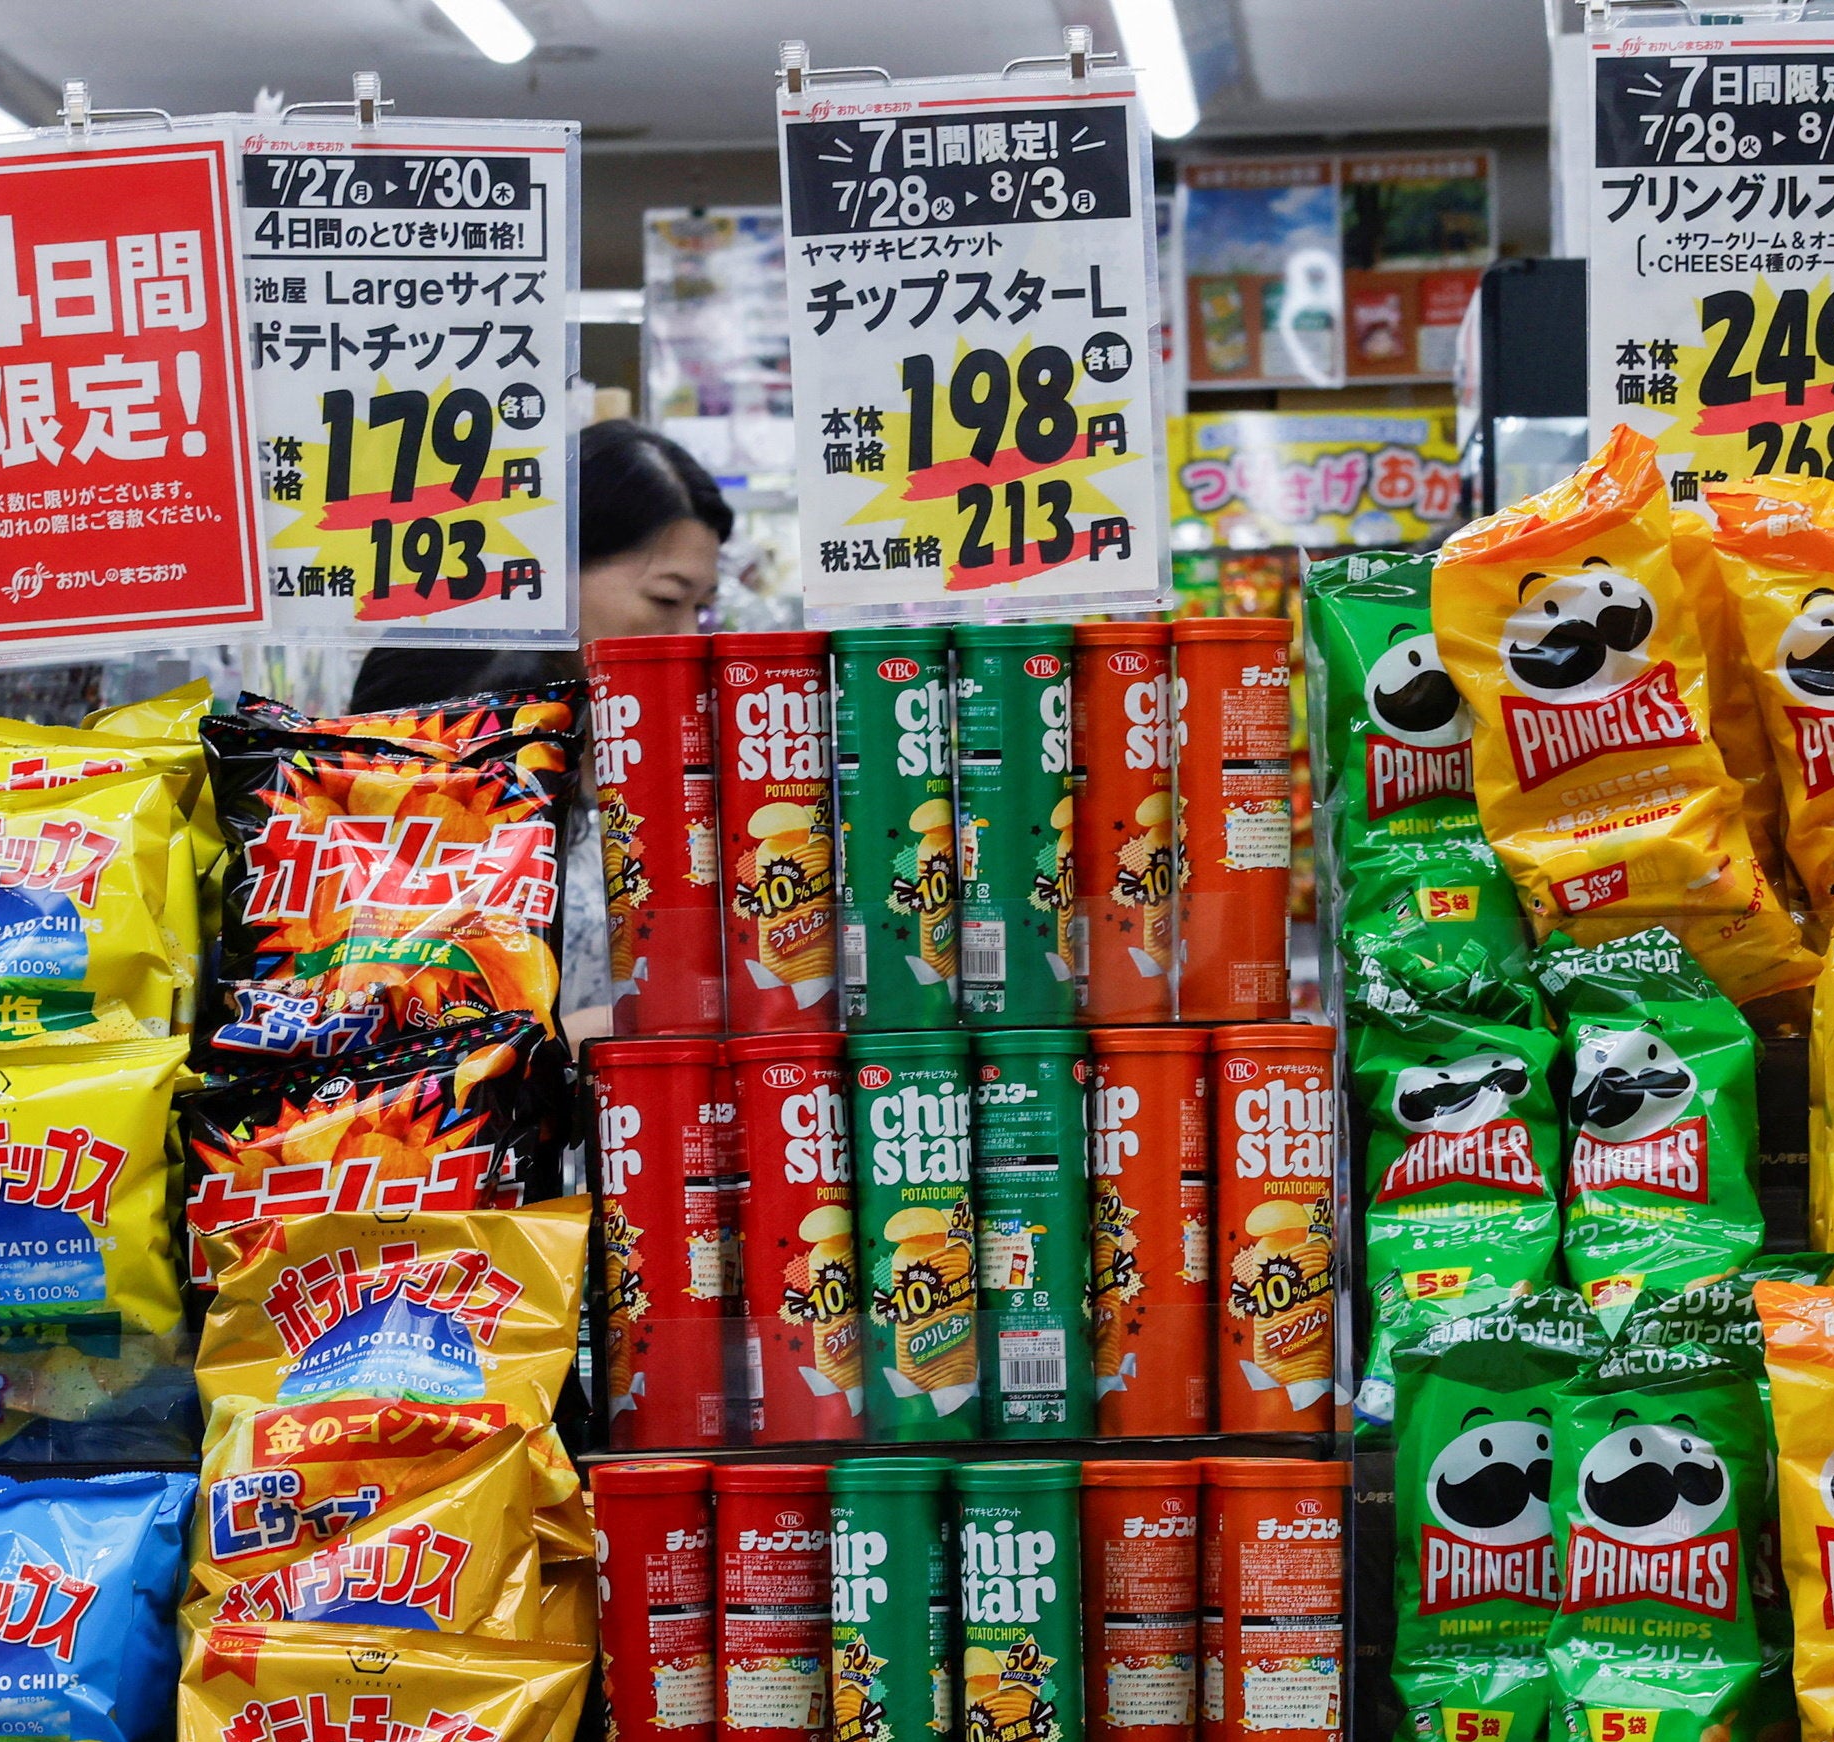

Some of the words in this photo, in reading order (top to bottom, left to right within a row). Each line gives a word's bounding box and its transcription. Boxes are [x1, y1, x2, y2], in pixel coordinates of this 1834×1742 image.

[859, 120, 1059, 174] 7日間限定!
[254, 216, 525, 250] 4日間のとびきり価格!
[801, 233, 1003, 268] ヤマザキビスケット
[244, 275, 307, 305] 池屋
[325, 270, 545, 308] Largeサイズ
[806, 265, 1127, 336] チップスターL
[251, 322, 541, 372] ポテトチップス
[820, 539, 942, 574] 税込価格
[1520, 673, 1687, 778] PRINGLES
[1229, 1059, 1256, 1081] YBC
[8, 1673, 80, 1692] CHIPS
